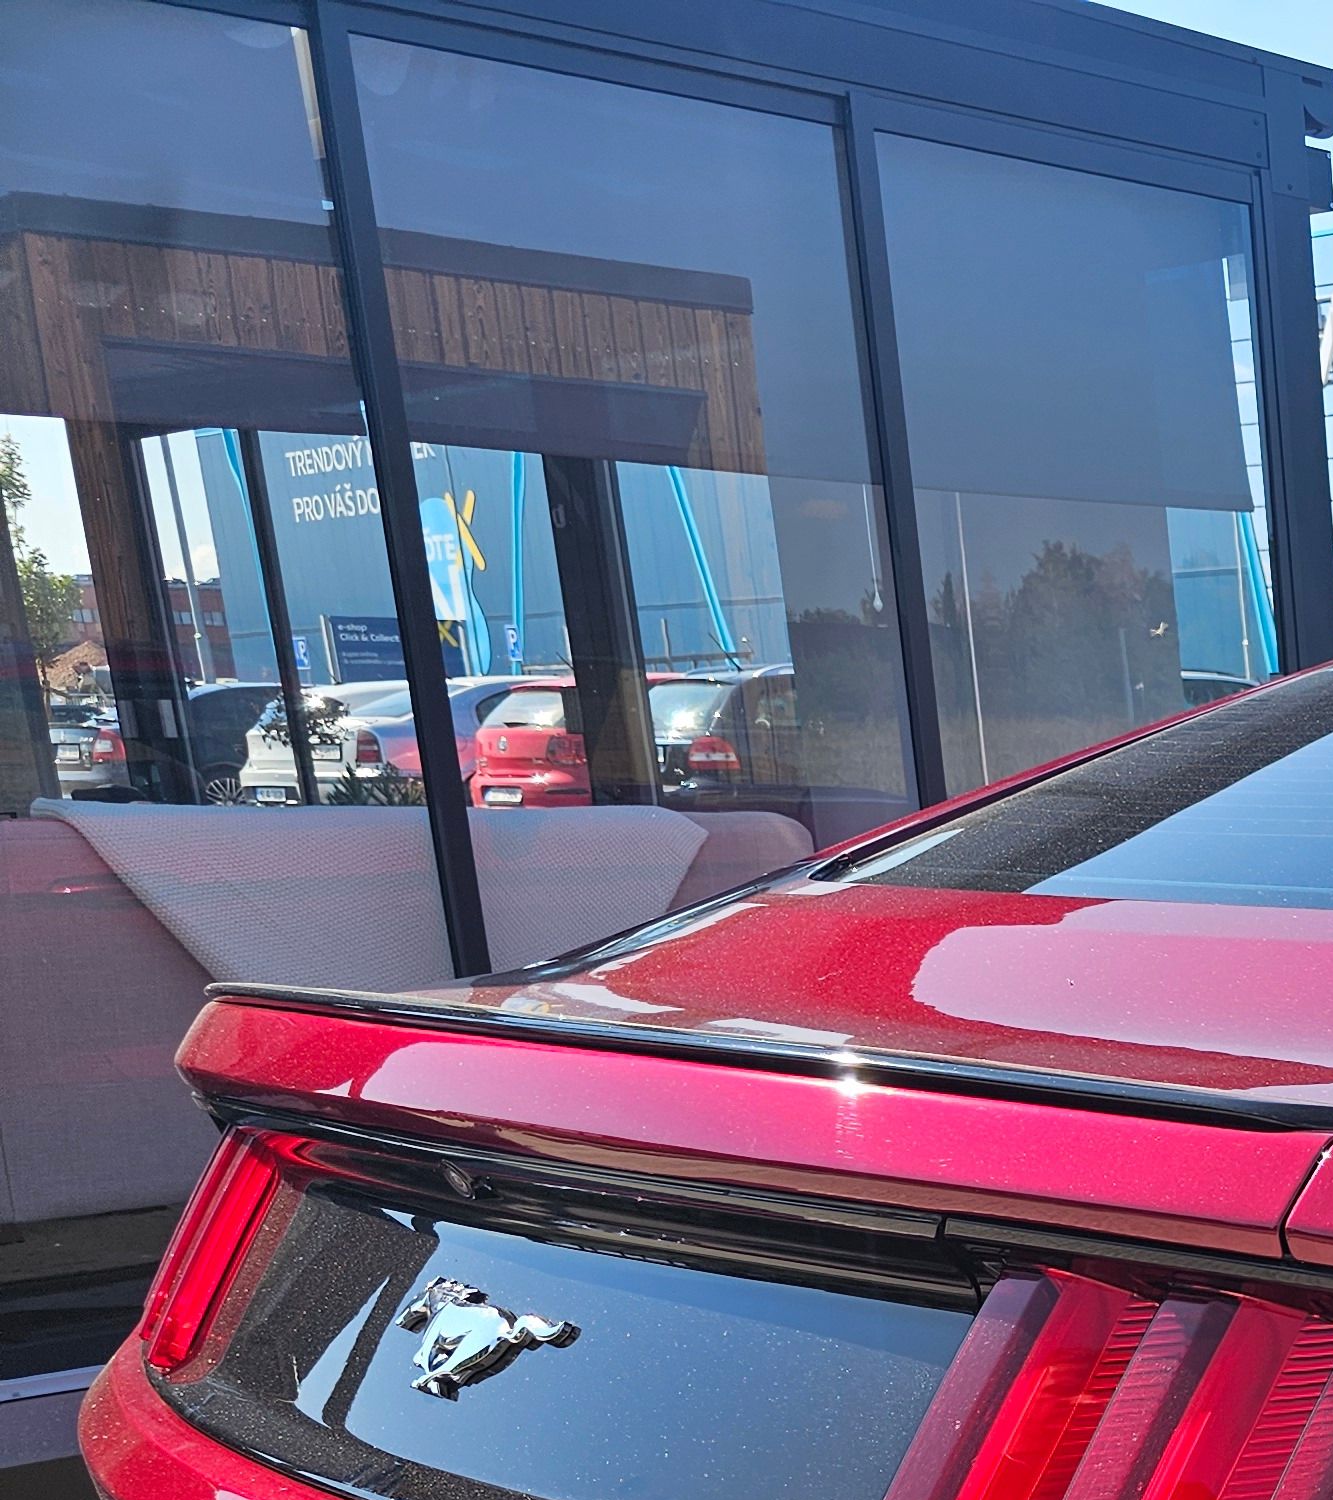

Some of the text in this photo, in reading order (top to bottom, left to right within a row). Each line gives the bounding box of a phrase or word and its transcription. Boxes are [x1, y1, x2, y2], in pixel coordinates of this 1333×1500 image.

[284, 435, 362, 477] TRENDOVÝ
[292, 494, 324, 523] PRO
[324, 483, 355, 519] VÁŠ
